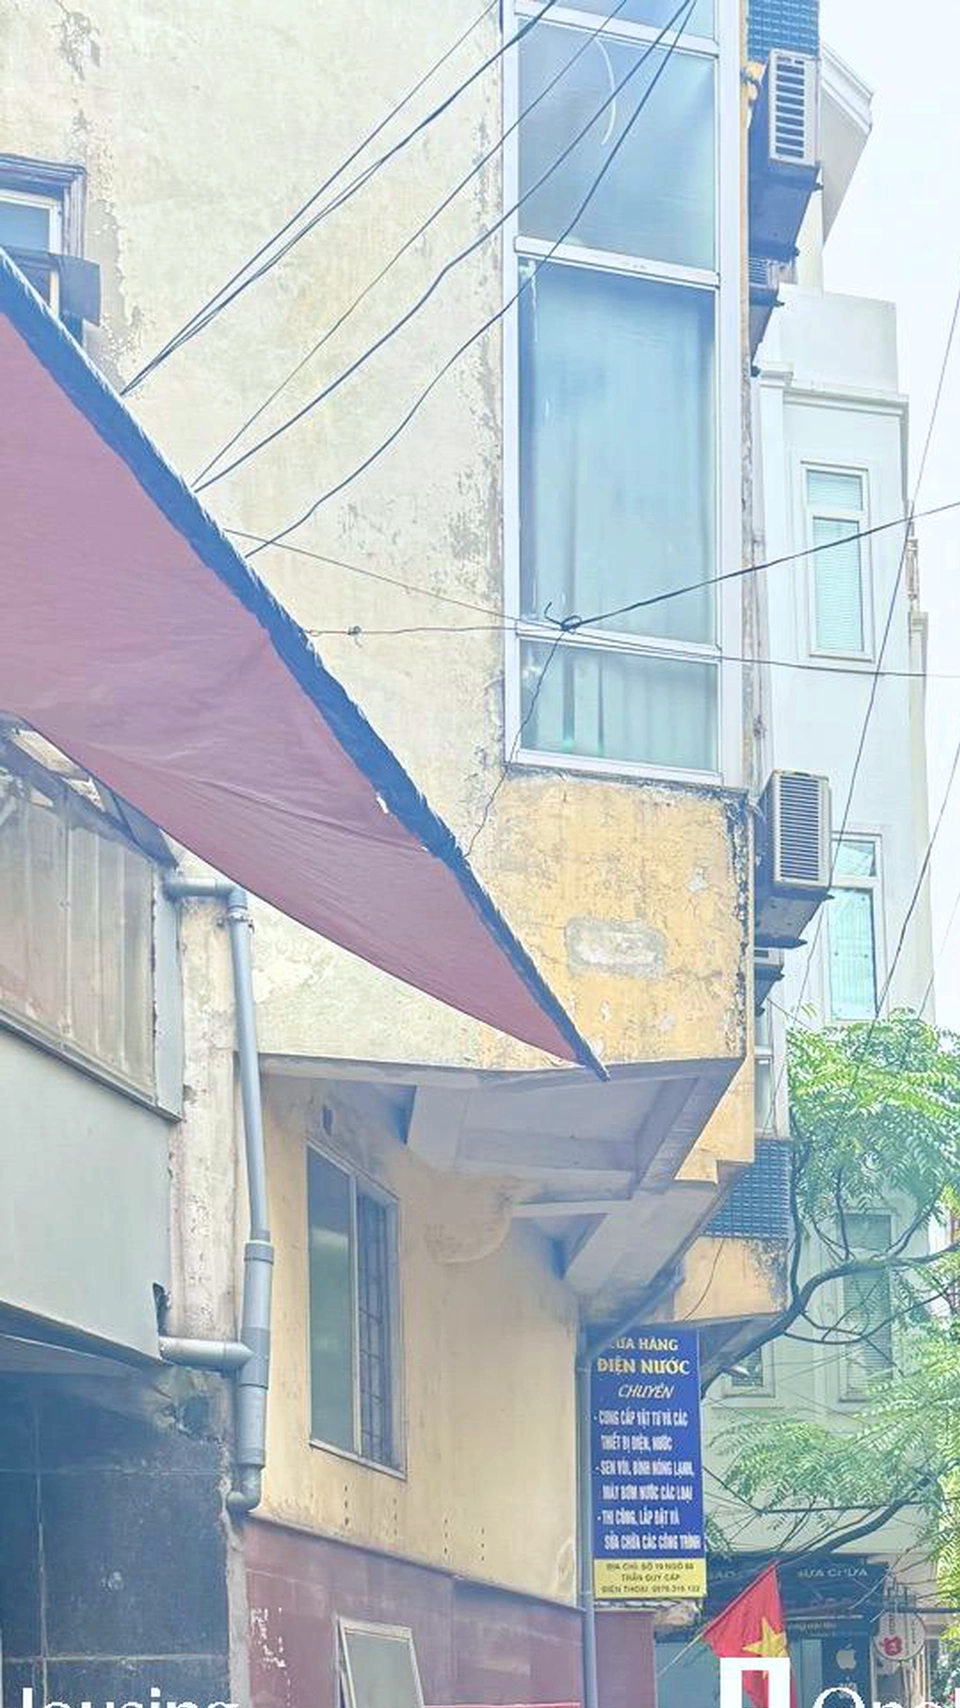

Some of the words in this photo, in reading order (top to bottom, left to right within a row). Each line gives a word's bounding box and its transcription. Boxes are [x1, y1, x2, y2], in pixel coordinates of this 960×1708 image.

[639, 1335, 679, 1351] HÀNG
[597, 1355, 636, 1376] ĐIỆN
[641, 1356, 691, 1375] NƯỚC
[618, 1383, 674, 1399] CHUYÊN
